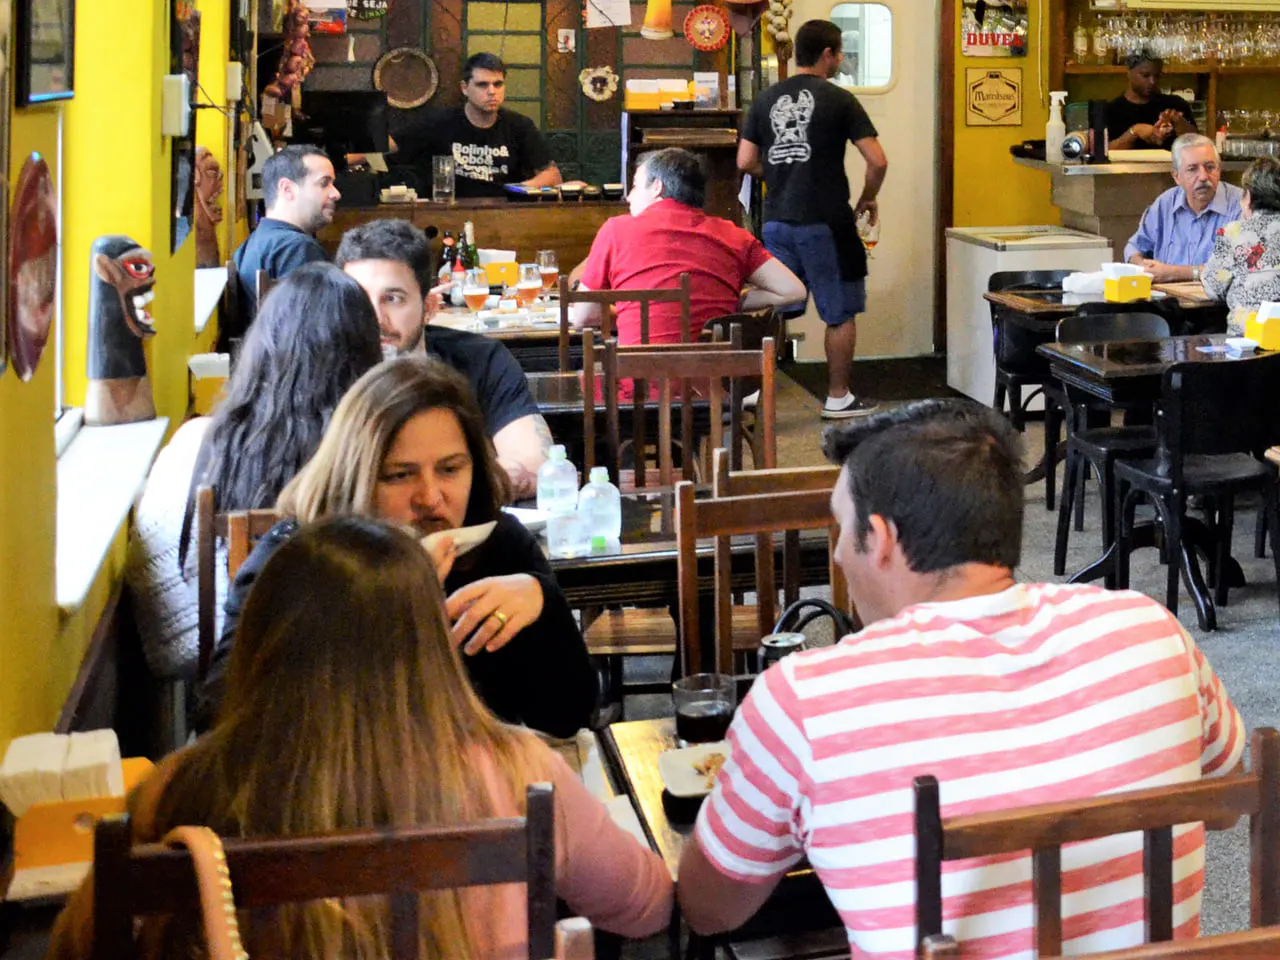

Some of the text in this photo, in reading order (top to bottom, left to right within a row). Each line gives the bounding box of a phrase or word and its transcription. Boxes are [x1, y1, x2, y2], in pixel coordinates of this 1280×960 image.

[362, 0, 388, 9] SEJA
[966, 32, 1024, 47] DUVEL
[452, 142, 509, 157] Bolinho&
